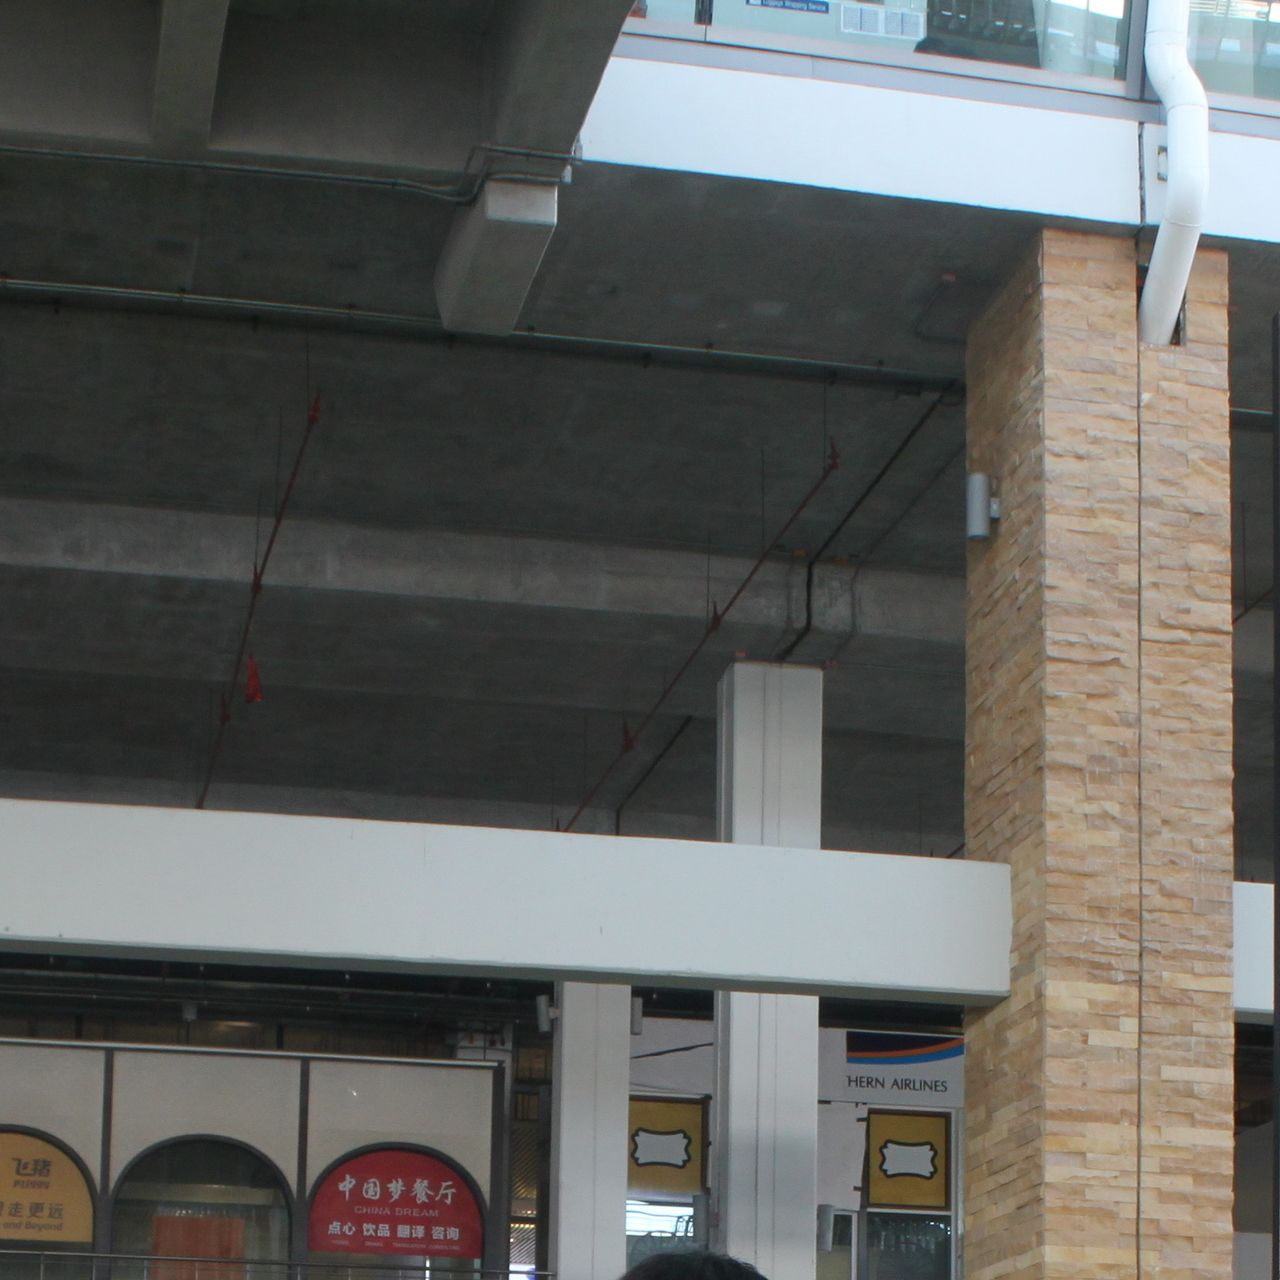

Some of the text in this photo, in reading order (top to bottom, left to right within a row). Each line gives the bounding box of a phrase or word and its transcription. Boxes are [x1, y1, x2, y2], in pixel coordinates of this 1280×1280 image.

[890, 1077, 948, 1093] AIRLINES
[337, 1174, 457, 1205] 中国梦餐厅
[354, 1205, 440, 1217] CHINA DREAM
[3, 1220, 22, 1231] and
[24, 1221, 64, 1232] Beyond
[328, 1221, 461, 1241] 点心 饮品 翻译 咨询
